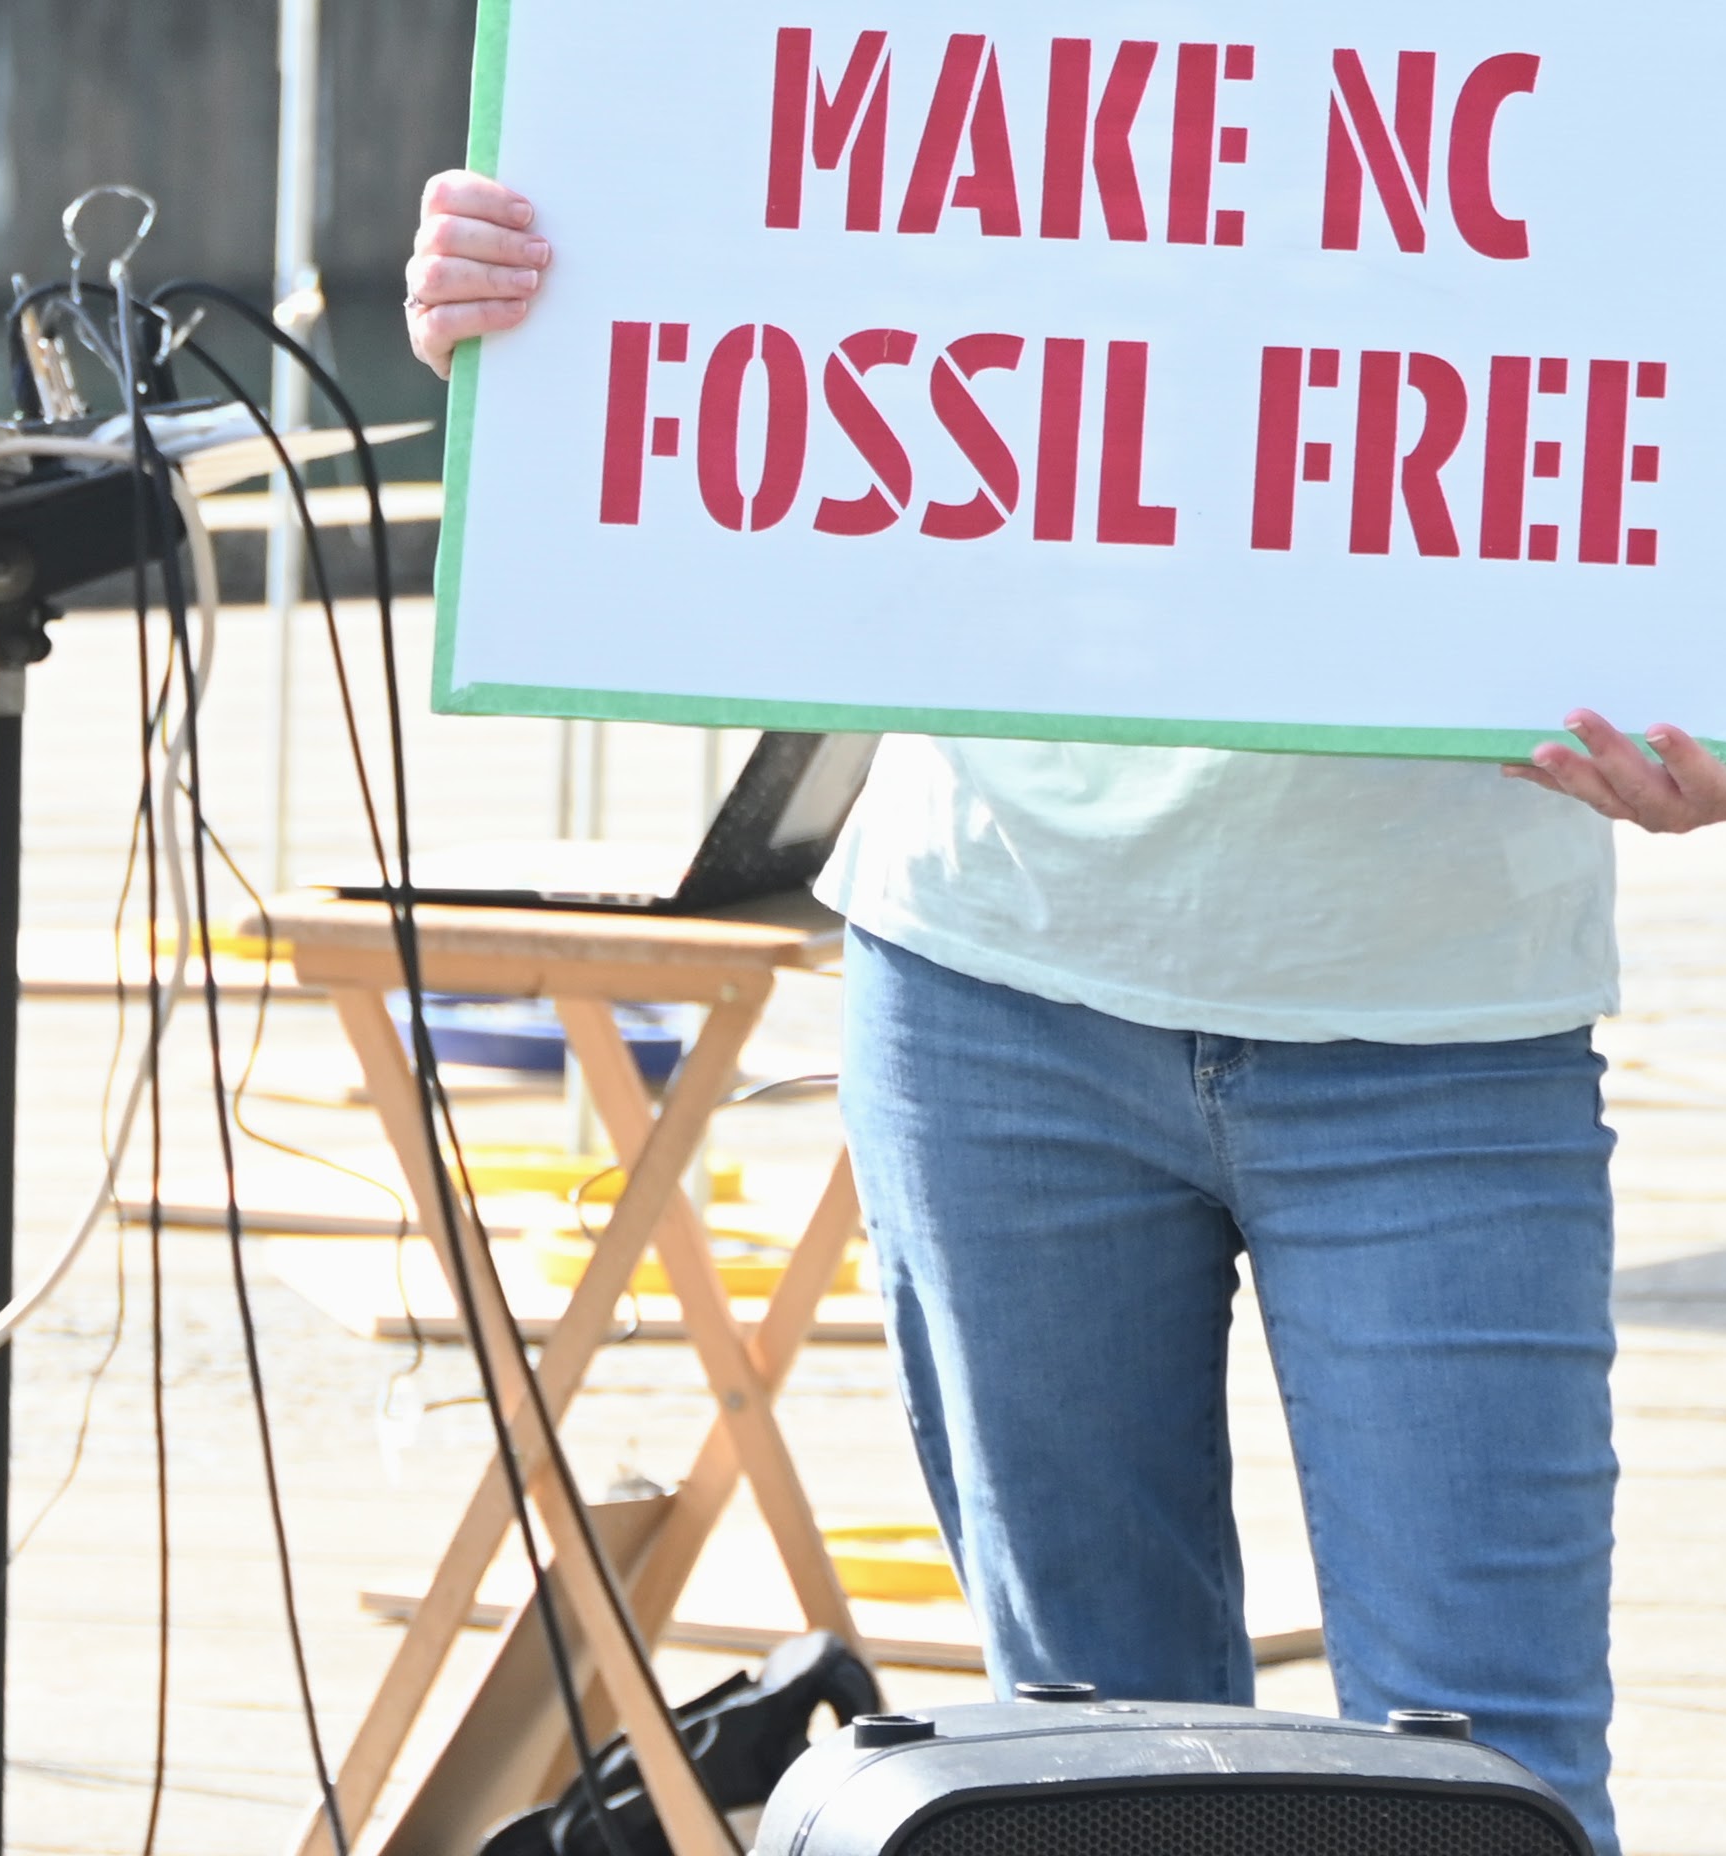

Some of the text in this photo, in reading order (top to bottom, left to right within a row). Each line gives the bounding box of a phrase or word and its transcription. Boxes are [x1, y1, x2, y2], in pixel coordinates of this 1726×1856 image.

[766, 27, 1541, 260] MAKE NC
[600, 320, 1667, 566] FOSSIL FREE
